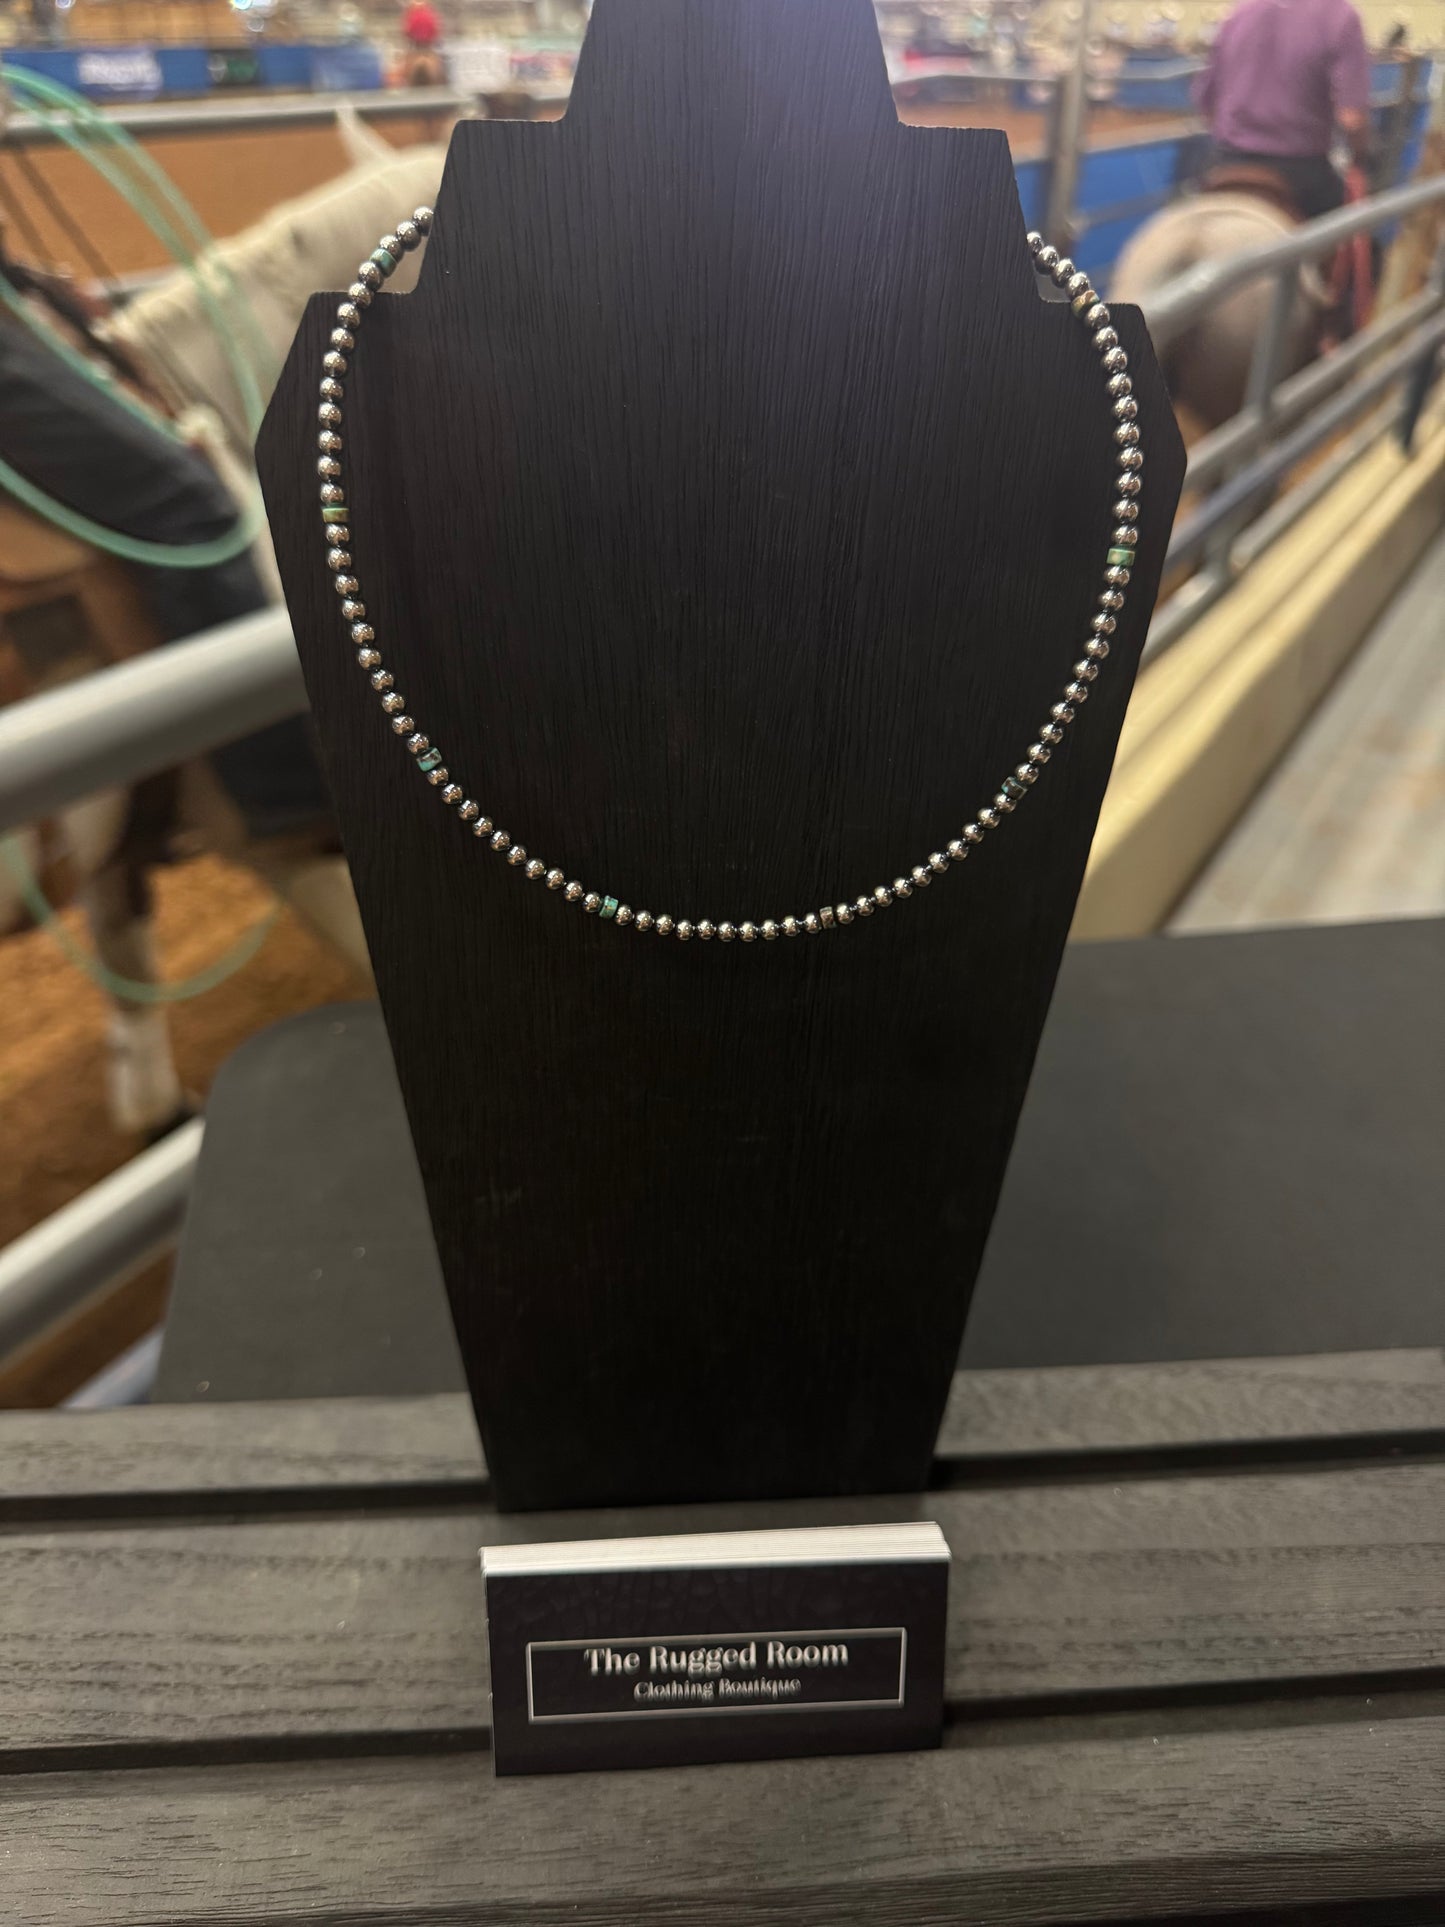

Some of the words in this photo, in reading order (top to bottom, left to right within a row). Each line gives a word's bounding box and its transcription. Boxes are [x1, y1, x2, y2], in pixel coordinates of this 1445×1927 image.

[584, 1646, 640, 1675] The
[650, 1641, 756, 1677] Rugged
[767, 1639, 849, 1668] Room
[634, 1679, 714, 1701] Clothing
[718, 1676, 801, 1699] Boutique
